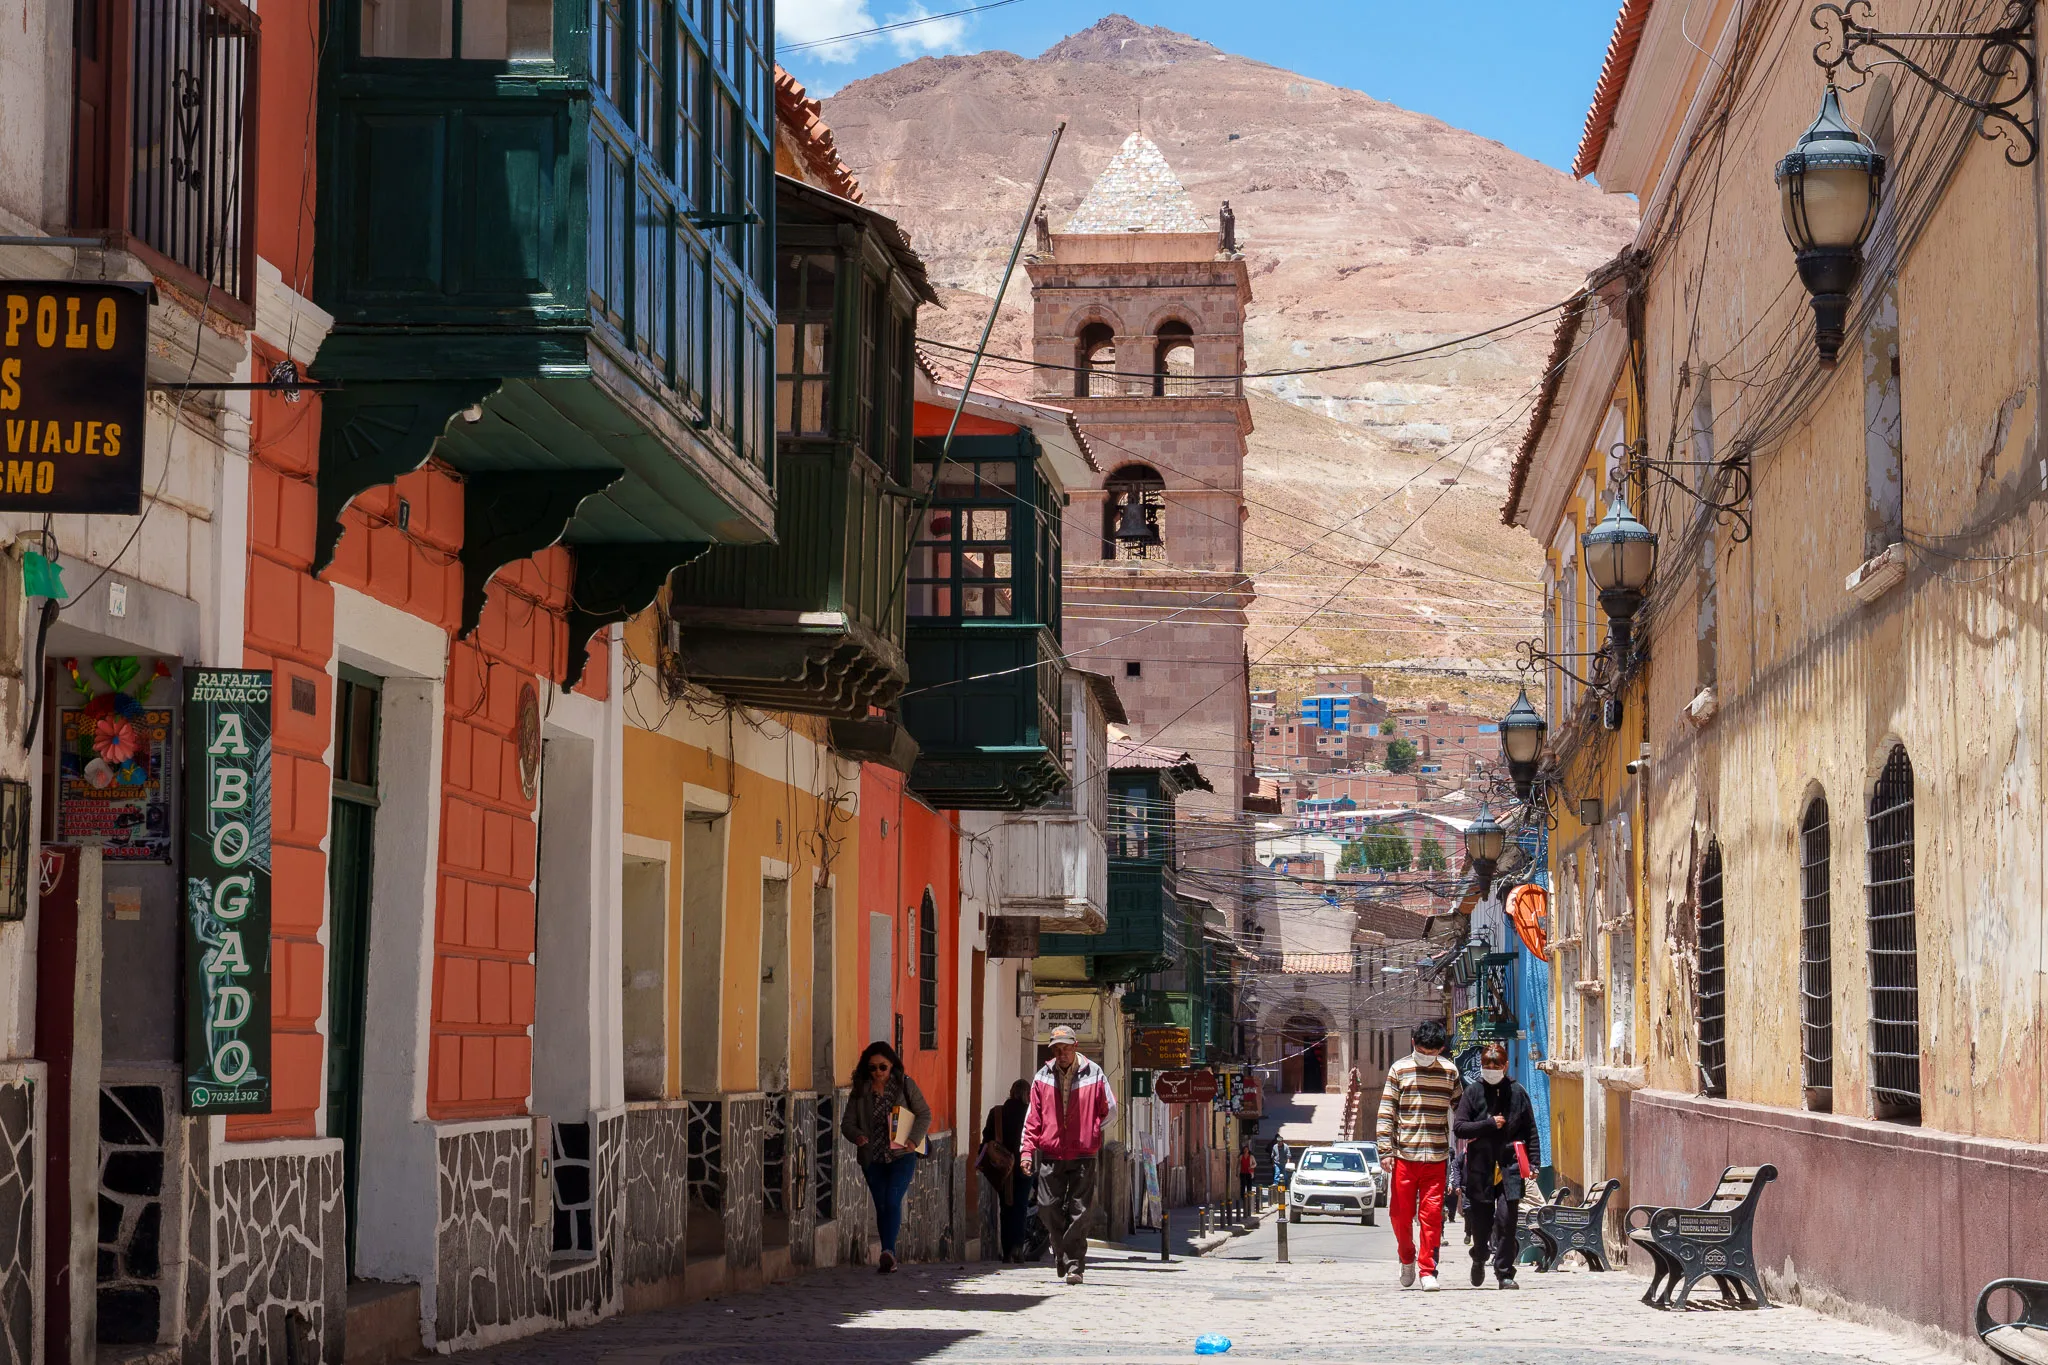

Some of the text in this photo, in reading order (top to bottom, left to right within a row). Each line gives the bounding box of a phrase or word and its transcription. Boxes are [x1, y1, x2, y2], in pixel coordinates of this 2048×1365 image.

[5, 294, 117, 350] POLO
[6, 419, 121, 457] VIAJES
[0, 460, 55, 495] MO
[192, 687, 268, 704] HUANACO
[197, 672, 263, 688] RAFAEL
[206, 712, 254, 1084] ABOGADO
[211, 1091, 259, 1103] 70321302
